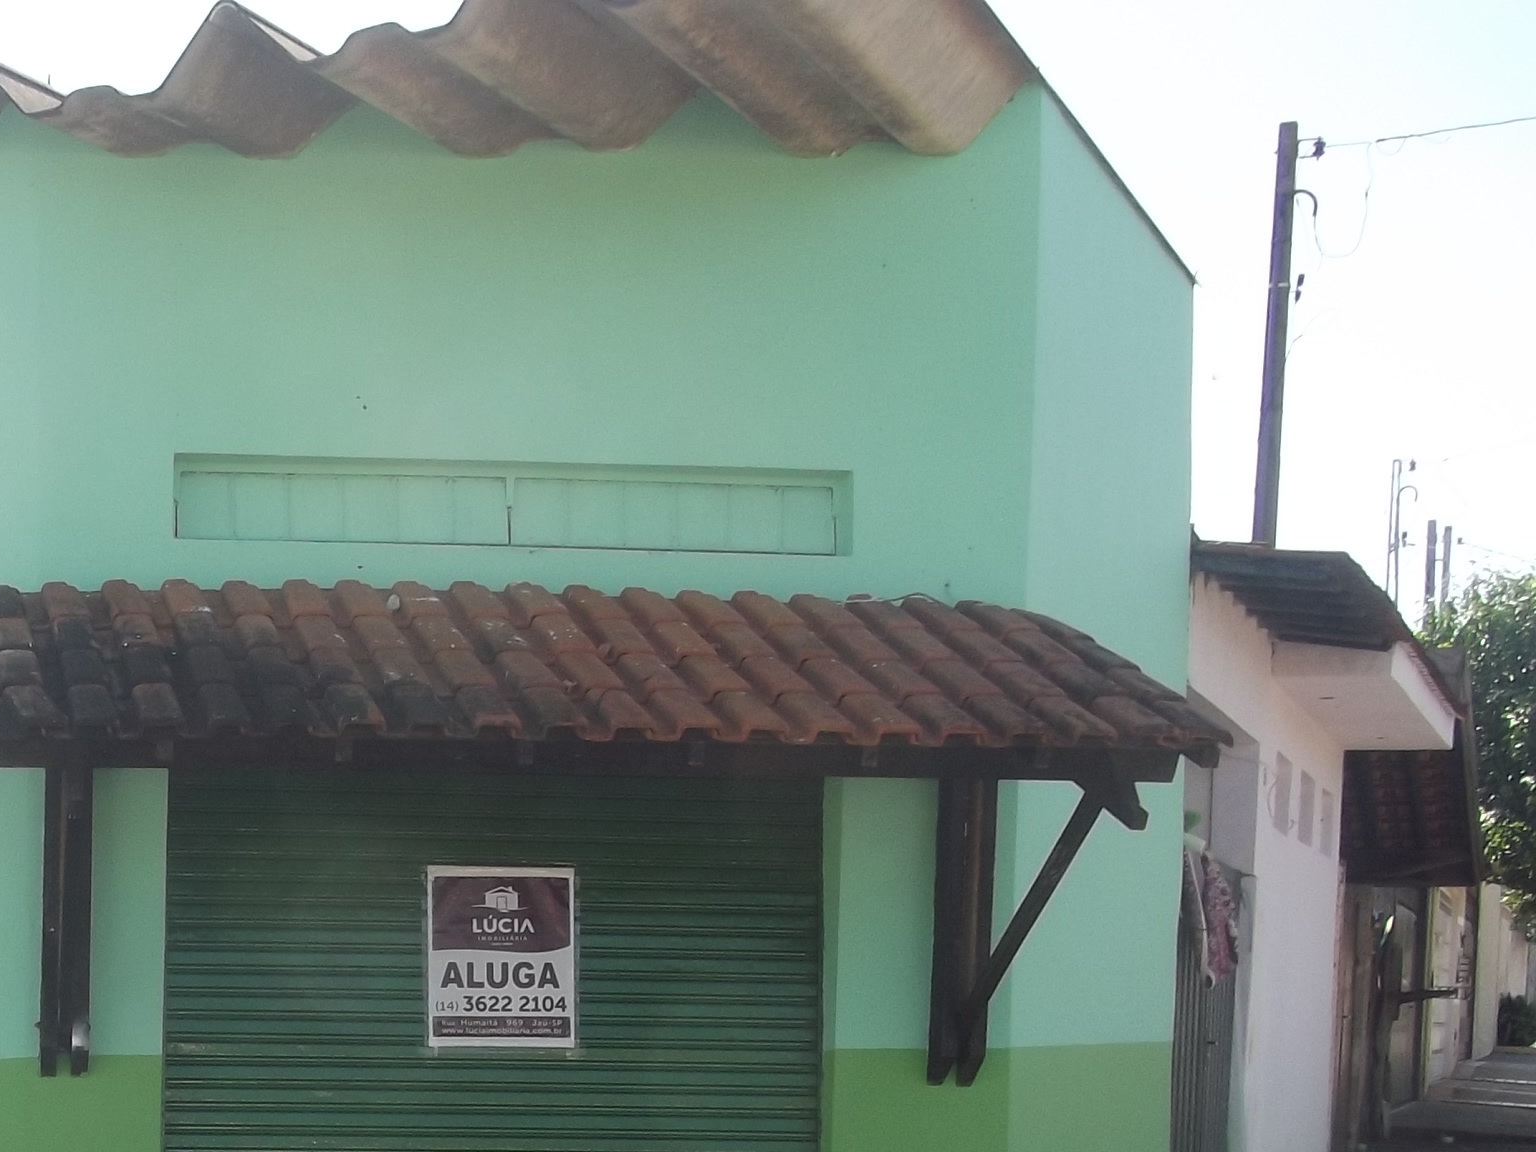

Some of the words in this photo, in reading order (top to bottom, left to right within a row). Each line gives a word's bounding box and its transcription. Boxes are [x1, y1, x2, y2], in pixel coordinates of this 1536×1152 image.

[472, 914, 535, 934] LÚCIA
[440, 961, 560, 989] ALUGA
[435, 1001, 459, 1012] (14)
[463, 995, 512, 1013] 3622
[519, 995, 567, 1013] 2104
[461, 1018, 498, 1027] Humaitá
